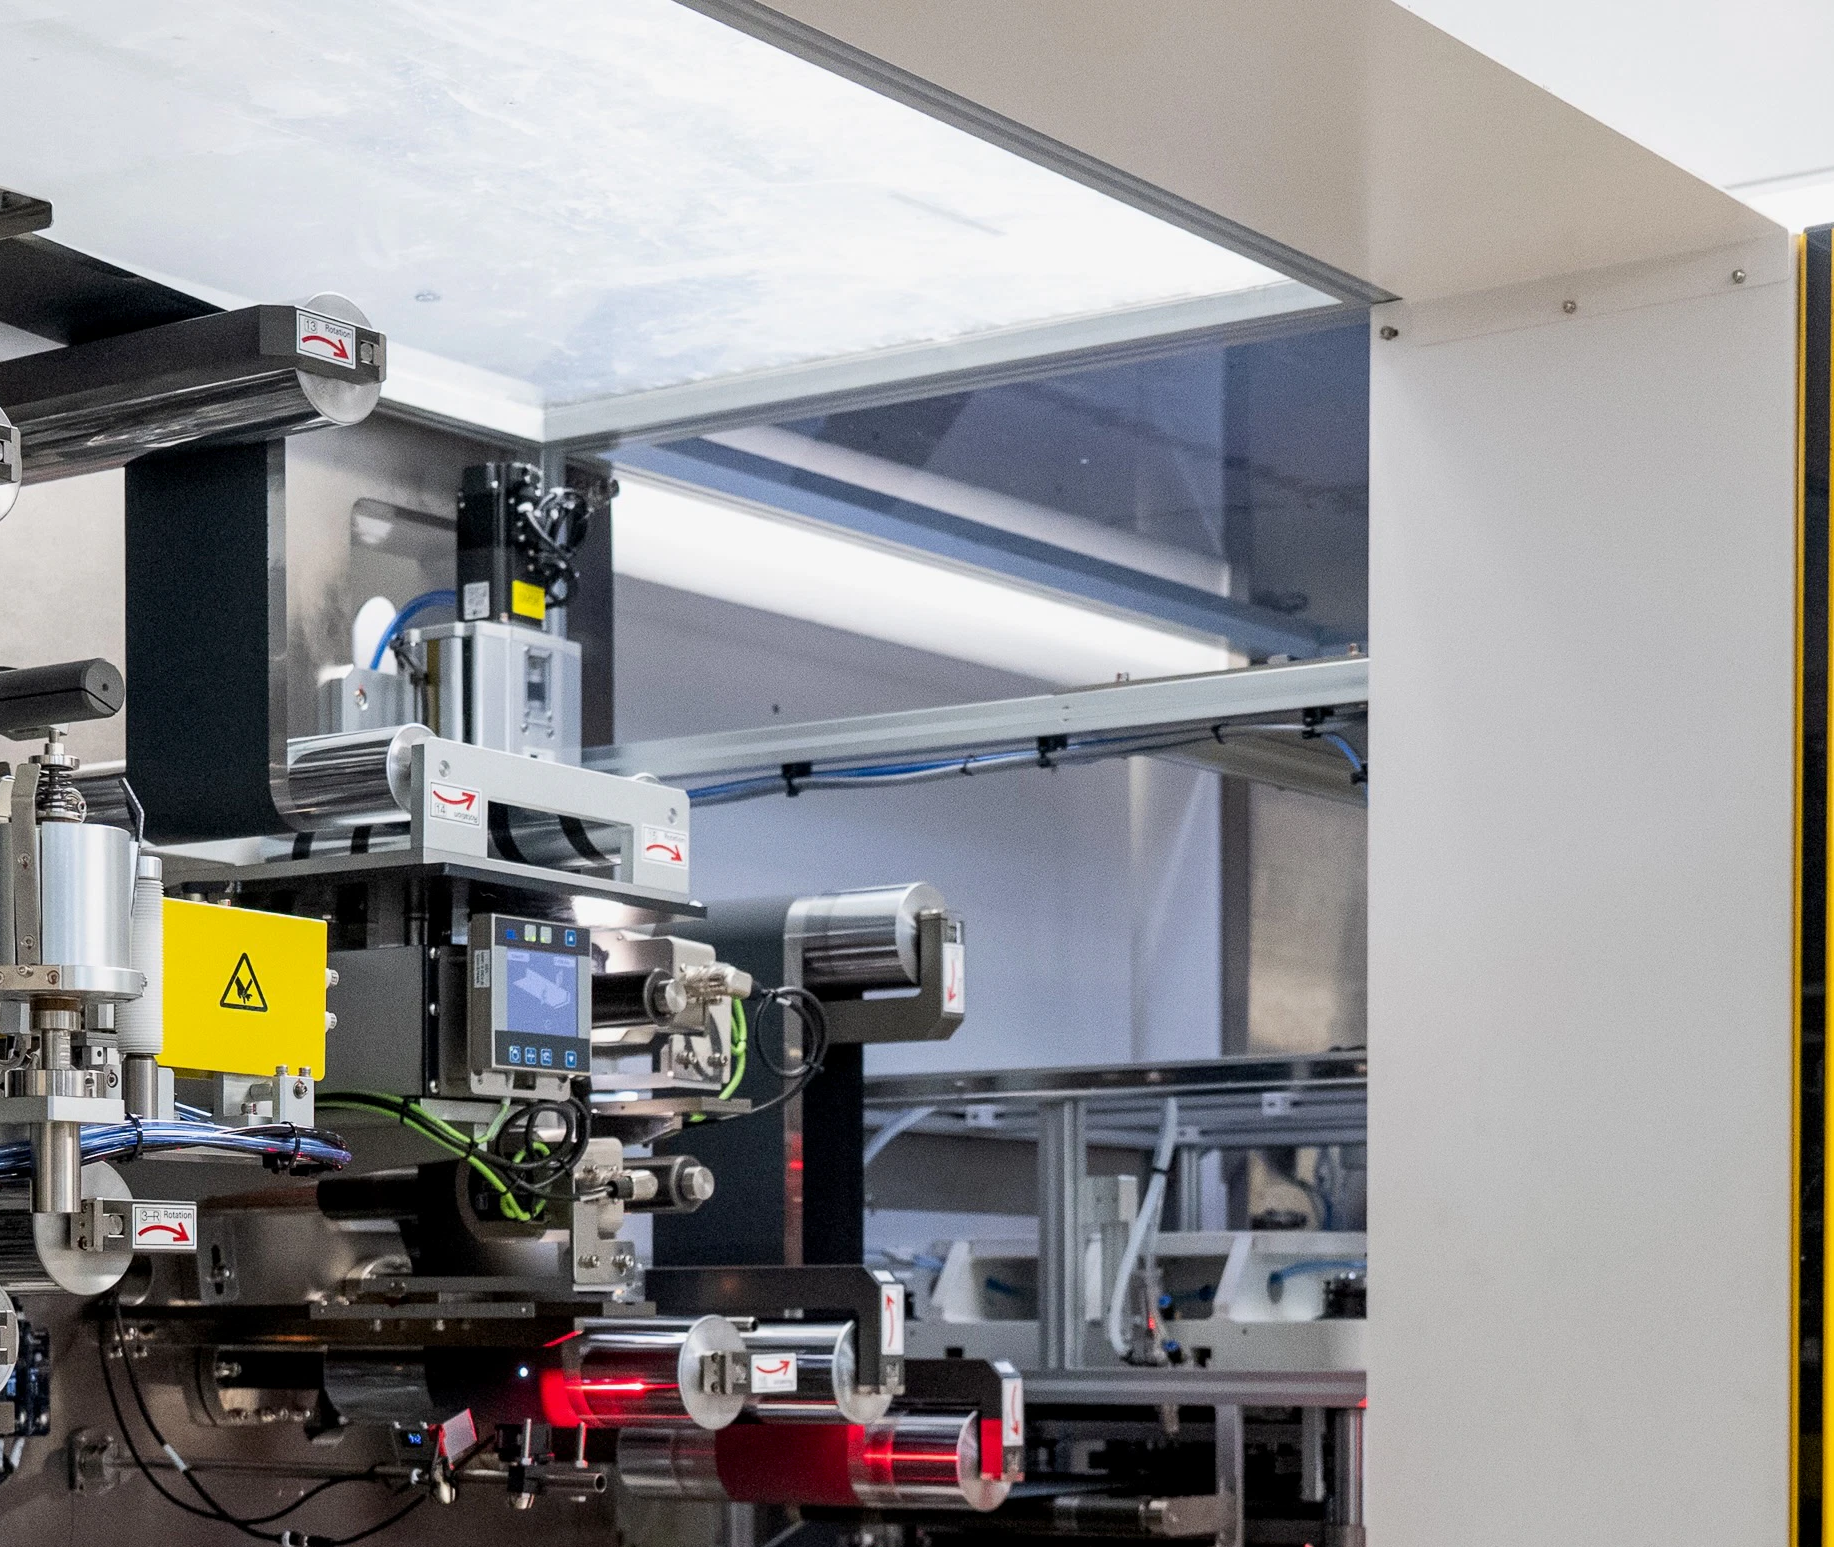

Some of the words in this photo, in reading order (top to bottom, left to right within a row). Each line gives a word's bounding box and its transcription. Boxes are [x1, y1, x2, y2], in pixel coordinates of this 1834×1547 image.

[306, 320, 317, 332] 13
[324, 323, 352, 339] Rotation
[163, 1210, 193, 1220] Rotation
